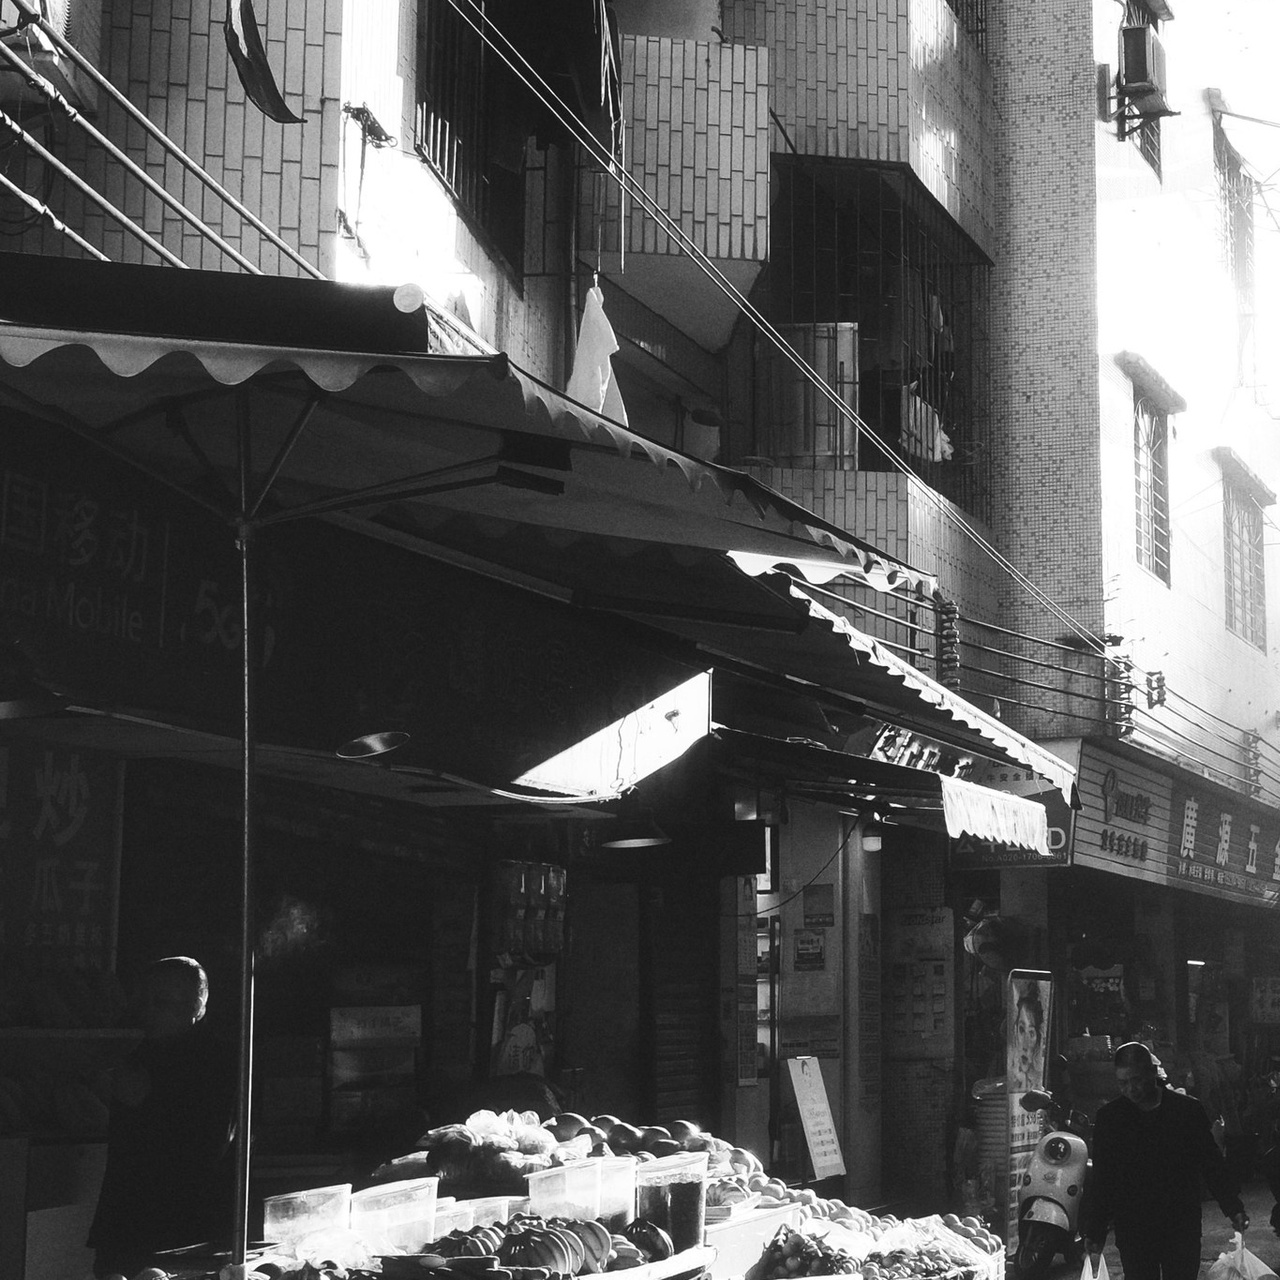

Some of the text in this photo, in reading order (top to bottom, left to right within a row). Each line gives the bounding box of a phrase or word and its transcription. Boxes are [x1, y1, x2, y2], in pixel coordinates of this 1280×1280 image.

[1, 472, 148, 583] 国移动
[46, 577, 143, 643] Mobile
[30, 858, 104, 916] 瓜子
